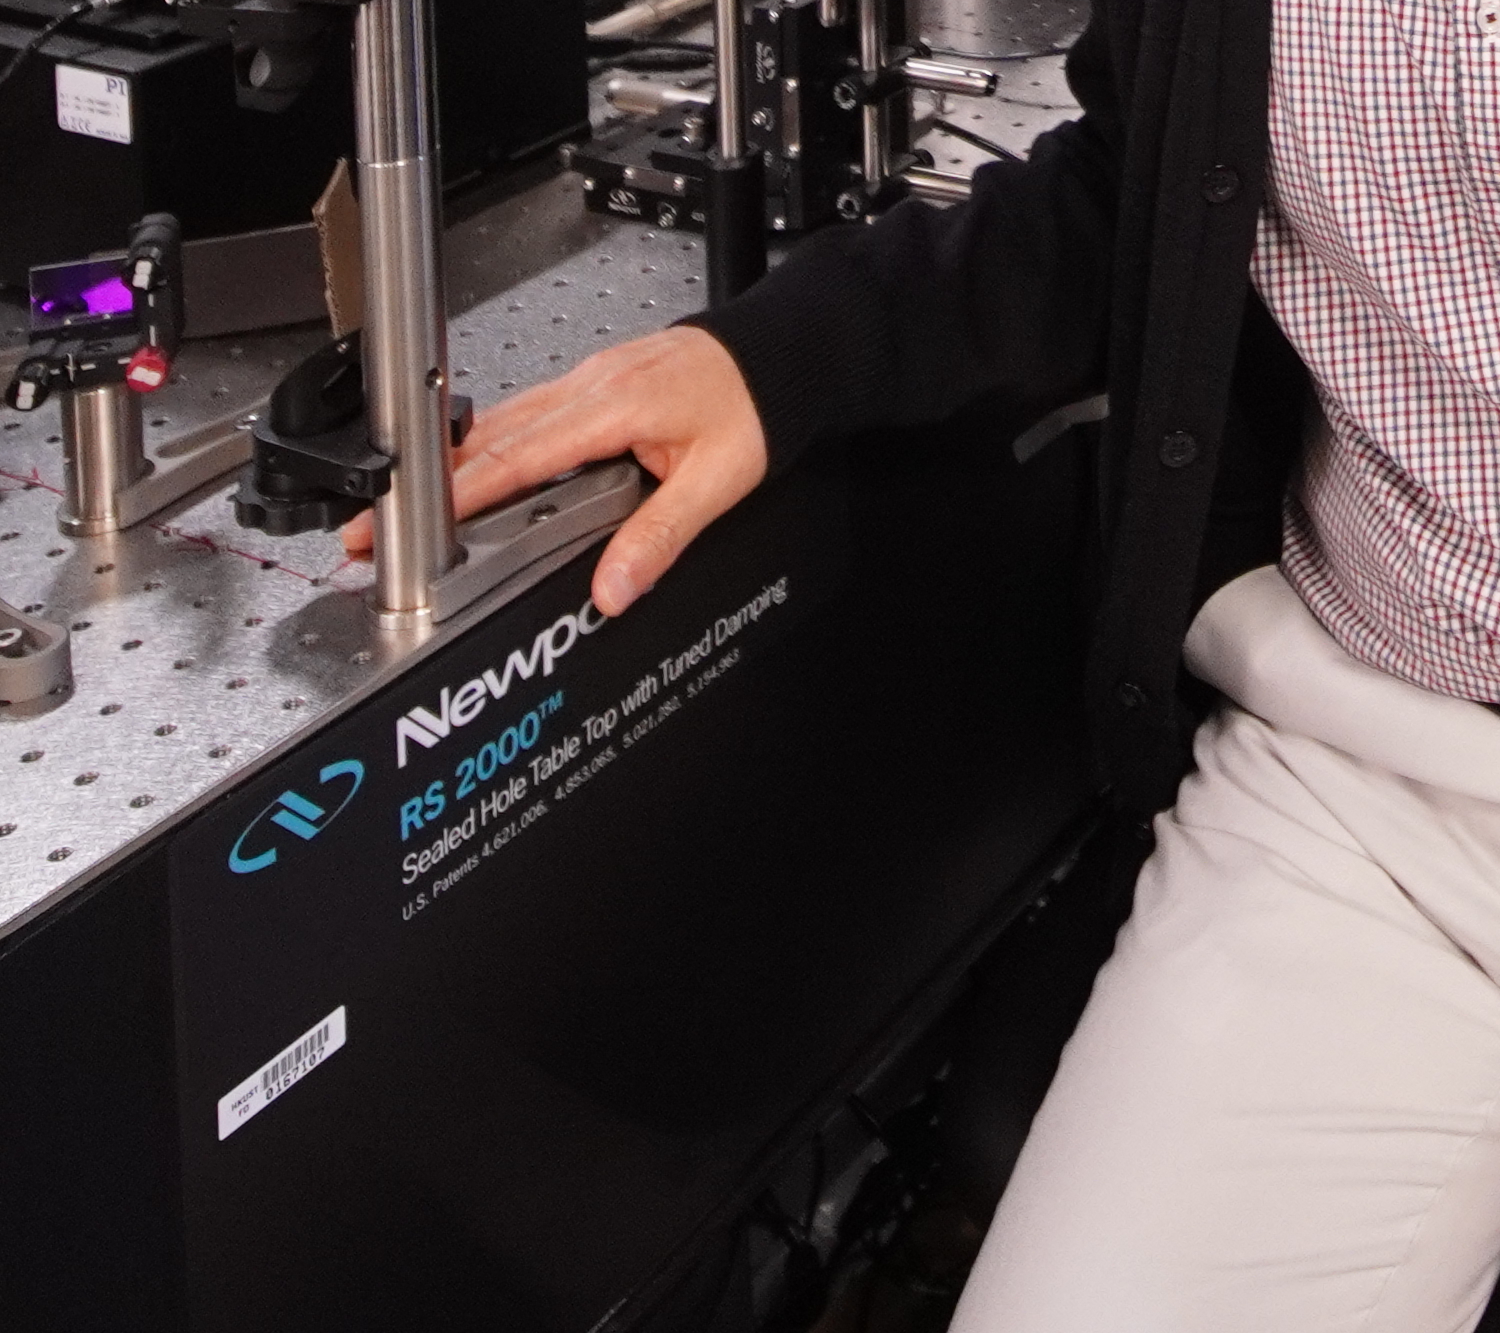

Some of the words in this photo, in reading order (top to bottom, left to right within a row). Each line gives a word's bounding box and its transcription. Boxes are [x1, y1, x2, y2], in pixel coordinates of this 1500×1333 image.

[105, 77, 128, 97] PI
[396, 599, 608, 769] Newpo
[402, 814, 475, 885] Sealed
[480, 777, 526, 827] Hole
[528, 733, 580, 786] Table
[581, 707, 617, 747] Top
[620, 674, 658, 717] with
[658, 629, 711, 684] Tuned
[713, 576, 788, 645] Damping
[400, 781, 445, 840] RS
[402, 893, 430, 921] U.S.
[433, 854, 479, 897] Patents
[231, 1085, 259, 1112] HKUST
[266, 1046, 325, 1101] 0167107
